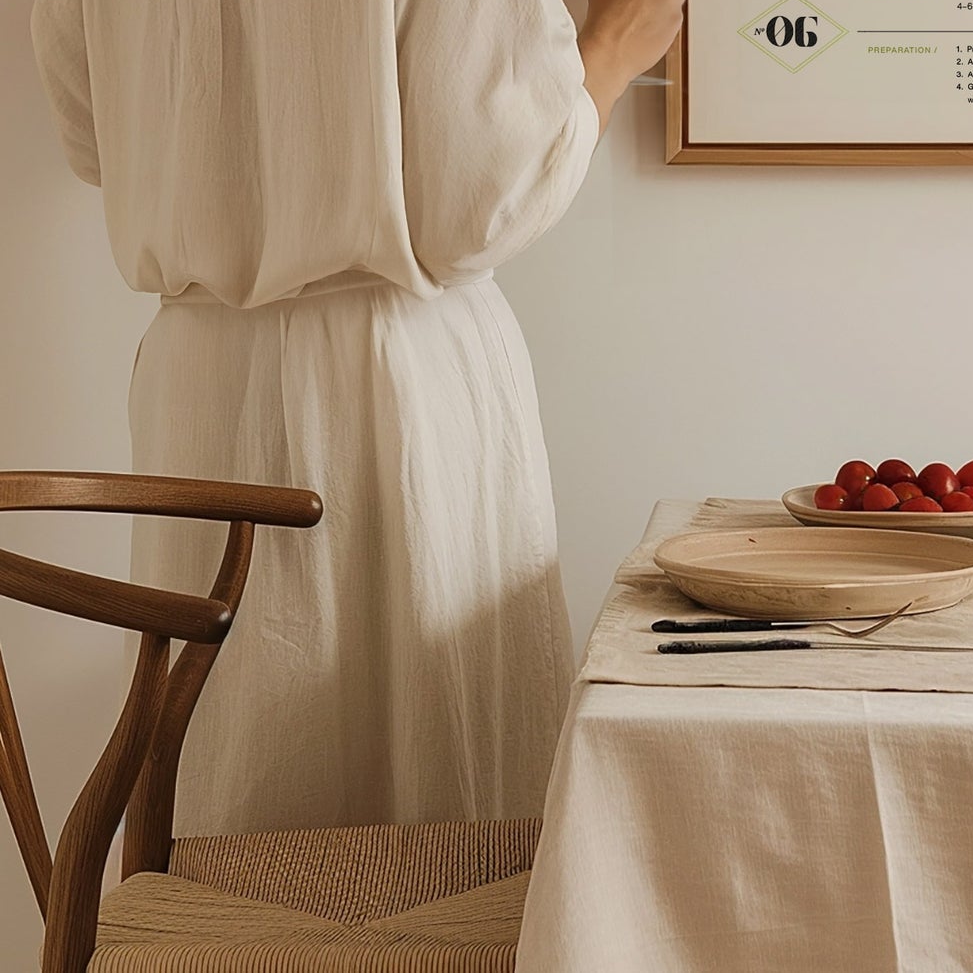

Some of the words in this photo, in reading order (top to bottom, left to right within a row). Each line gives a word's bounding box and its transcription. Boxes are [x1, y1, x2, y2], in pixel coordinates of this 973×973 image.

[766, 15, 818, 48] 06
[866, 45, 931, 55] PREPARATION
[955, 45, 963, 54] 1.
[955, 57, 964, 66] 2.
[955, 70, 964, 79] 3.
[955, 82, 964, 91] 4.
